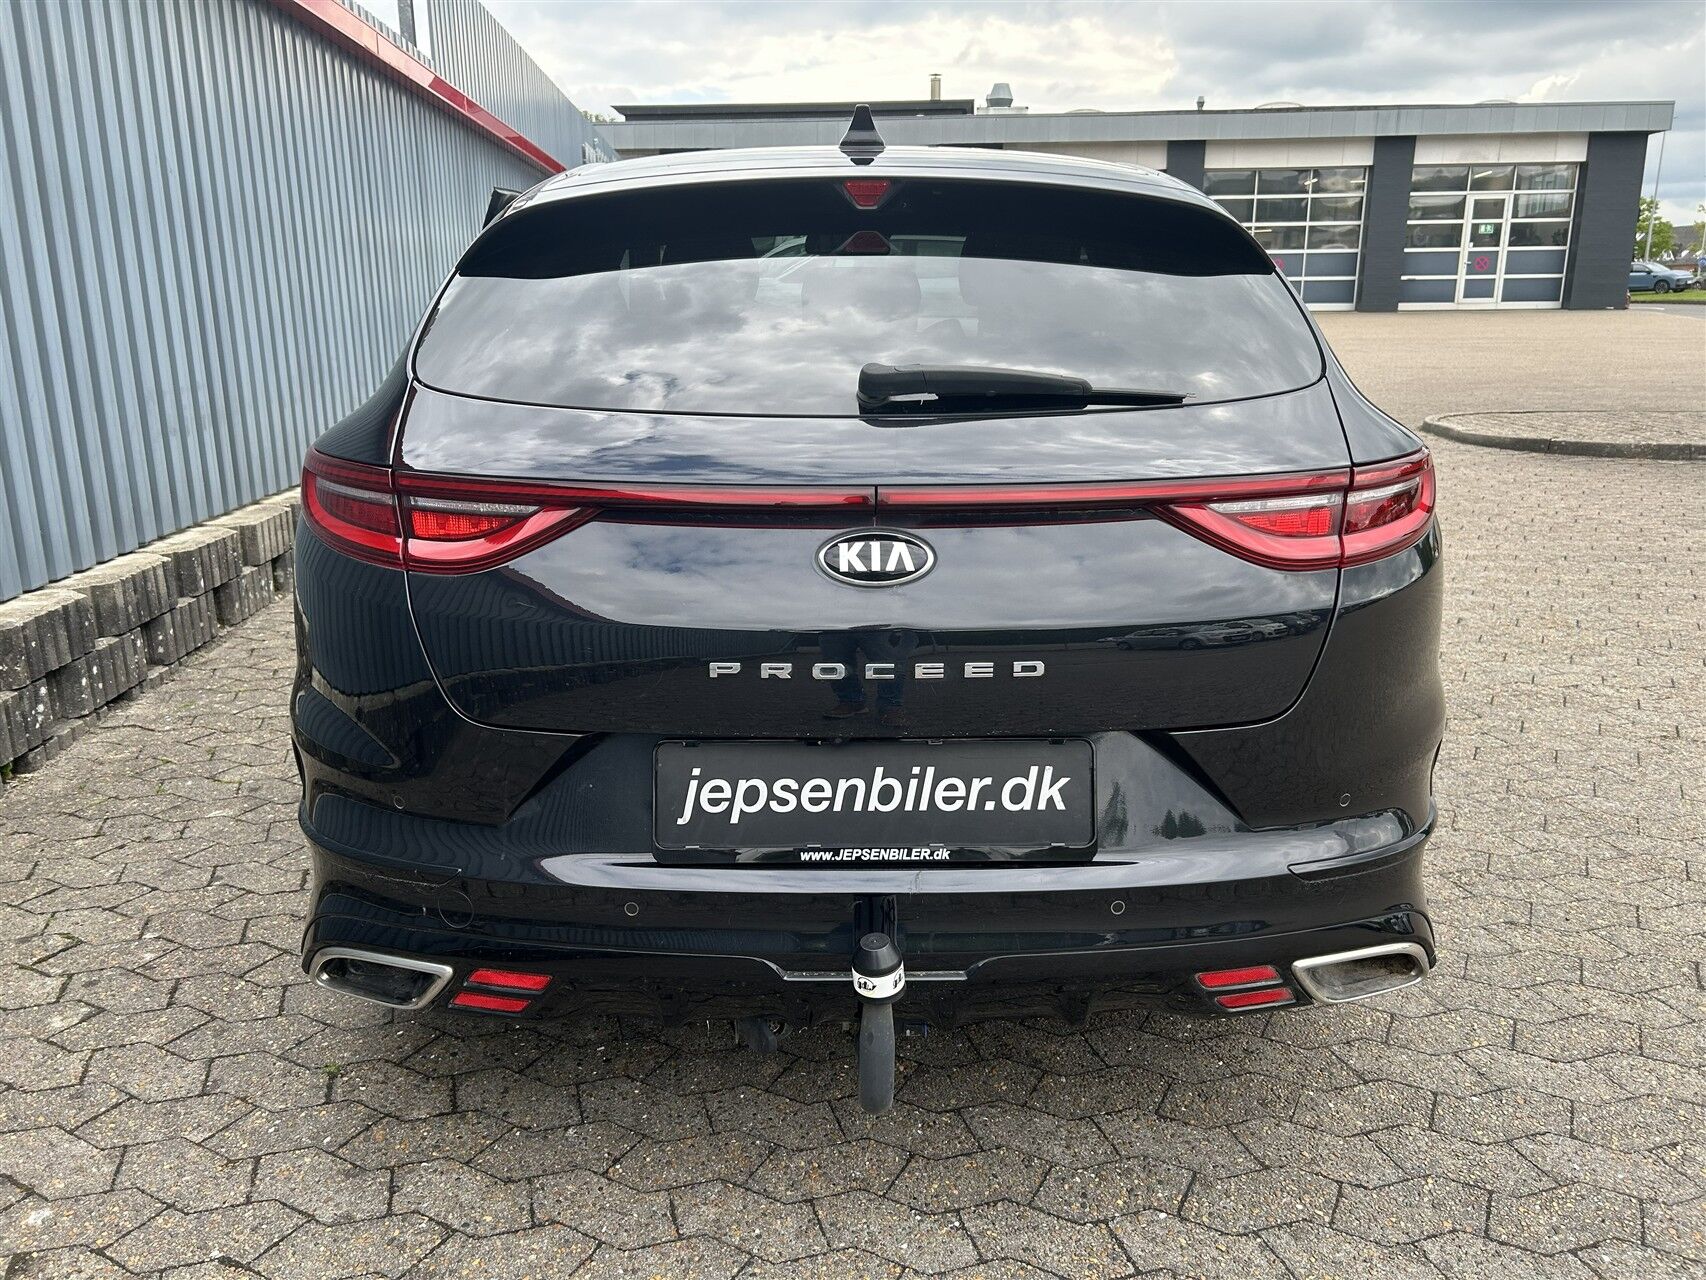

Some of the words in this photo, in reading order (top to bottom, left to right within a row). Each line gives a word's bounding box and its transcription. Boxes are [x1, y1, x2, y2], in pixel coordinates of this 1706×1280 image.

[837, 540, 916, 573] KIA
[709, 660, 1045, 680] PROCEED
[677, 765, 1071, 825] jepsenbiler.dk
[800, 848, 951, 862] www.JEPSENBILER.dk
